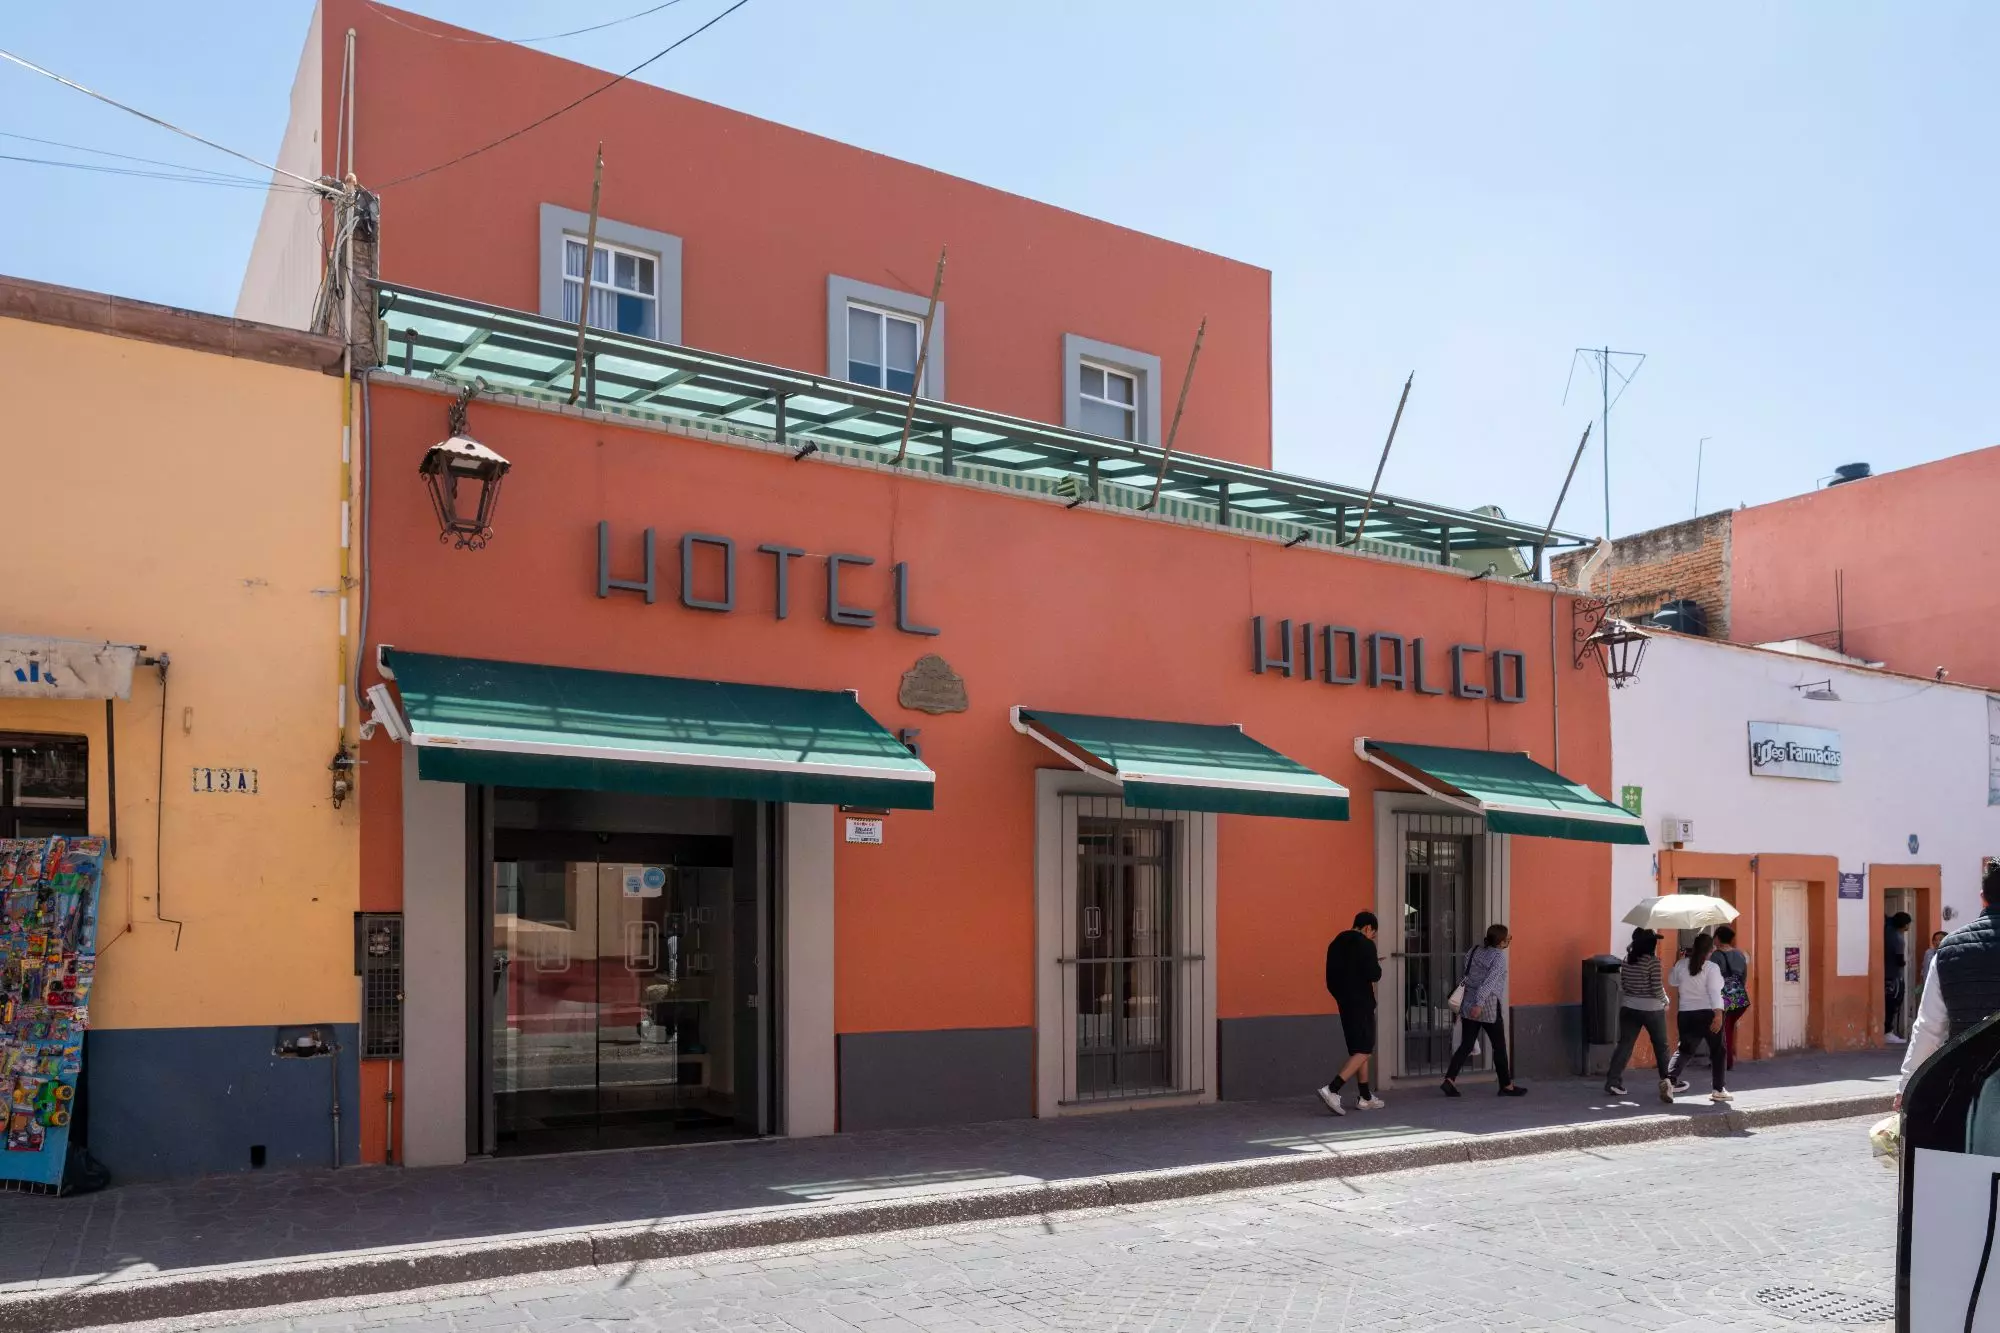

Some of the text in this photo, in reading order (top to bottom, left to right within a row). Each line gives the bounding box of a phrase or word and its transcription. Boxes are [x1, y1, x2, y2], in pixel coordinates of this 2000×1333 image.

[597, 520, 940, 637] HOTEL
[1252, 615, 1527, 703] HIDALGO
[204, 768, 247, 791] 13A
[1786, 741, 1841, 767] Farmacias
